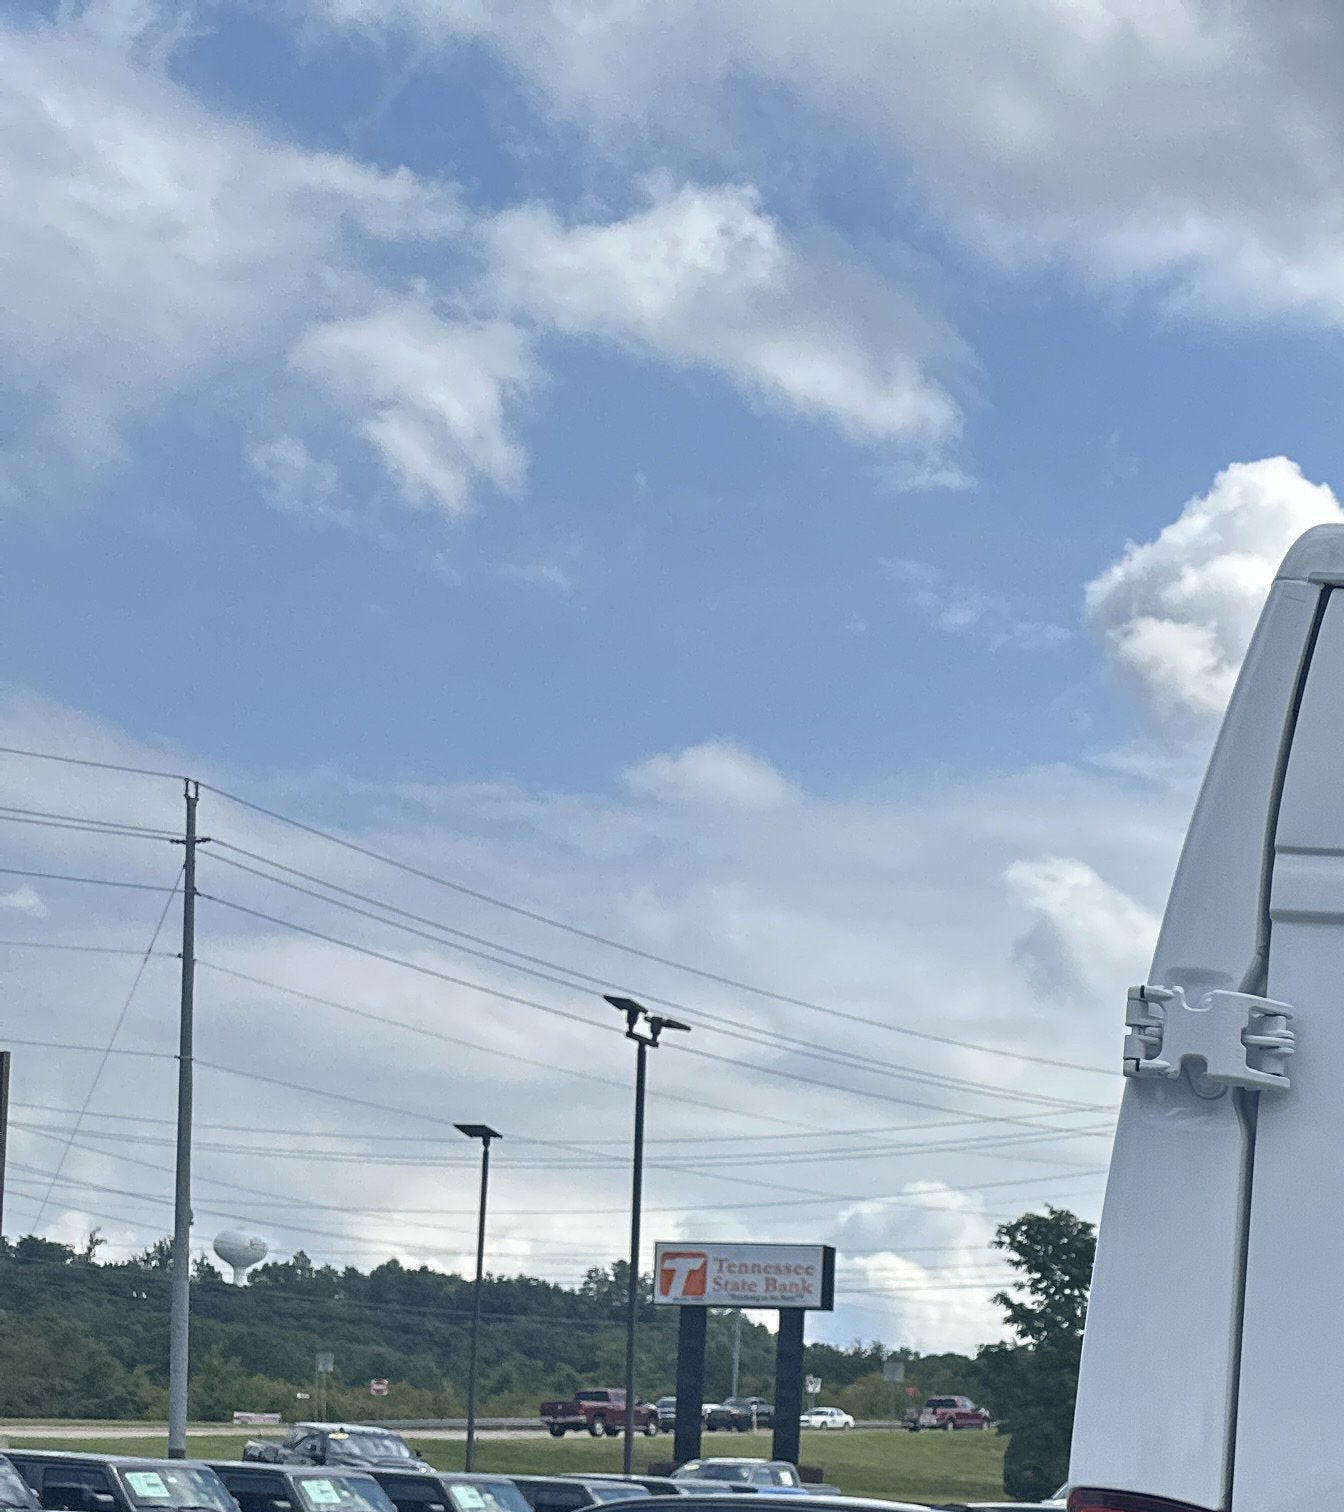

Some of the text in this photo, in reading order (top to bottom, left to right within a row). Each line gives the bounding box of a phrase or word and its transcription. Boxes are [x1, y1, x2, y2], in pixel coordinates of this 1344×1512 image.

[713, 1257, 815, 1277] Tennessee
[712, 1276, 814, 1295] State Bank
